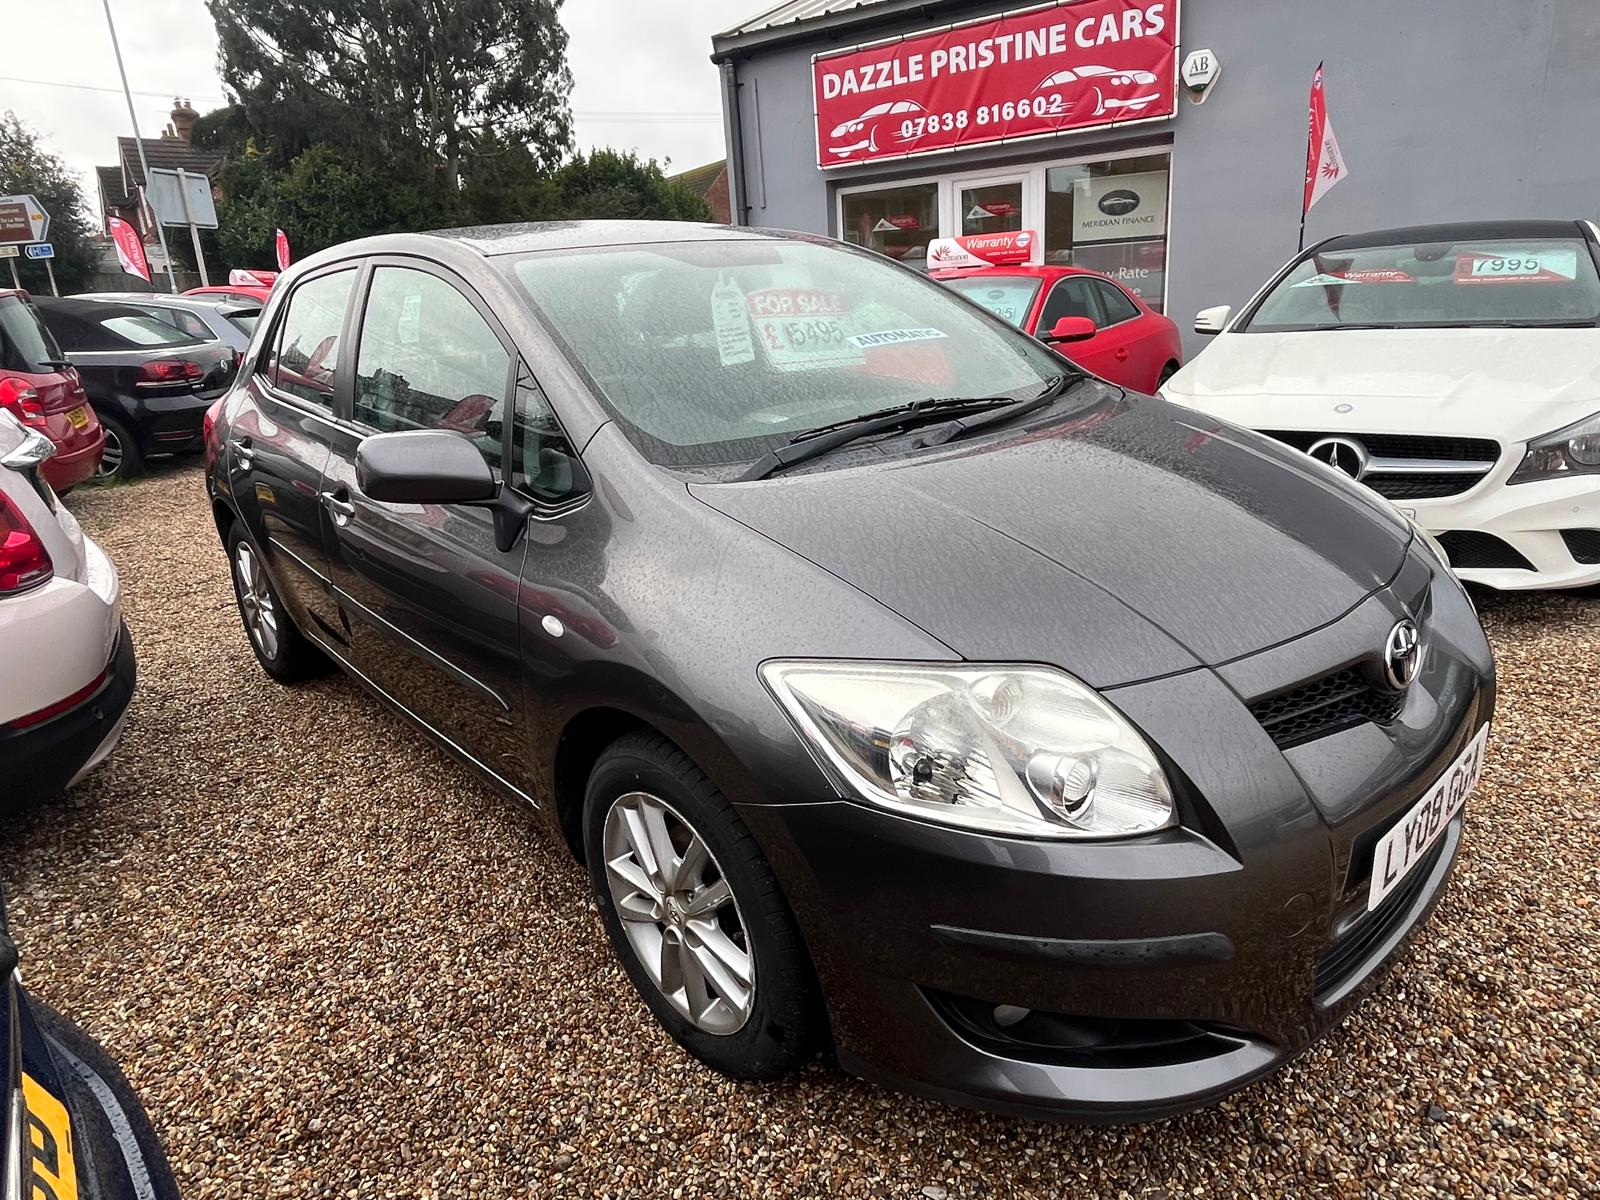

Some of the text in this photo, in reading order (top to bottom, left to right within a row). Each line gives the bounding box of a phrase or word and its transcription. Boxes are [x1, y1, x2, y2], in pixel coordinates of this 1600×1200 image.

[822, 4, 1165, 100] DAZZLE PRISTINE CARS
[1190, 56, 1209, 73] AB
[900, 93, 1063, 139] 07838 816602
[1082, 215, 1155, 228] MERIDIAN FINANCE
[967, 237, 1014, 249] Warranty
[1119, 267, 1149, 279] Rate
[1476, 258, 1539, 272] 7995
[1344, 271, 1398, 279] Warranty
[753, 294, 842, 313] FOR SALE
[856, 329, 941, 346] AUTOMATIC
[1382, 786, 1446, 889] LY08
